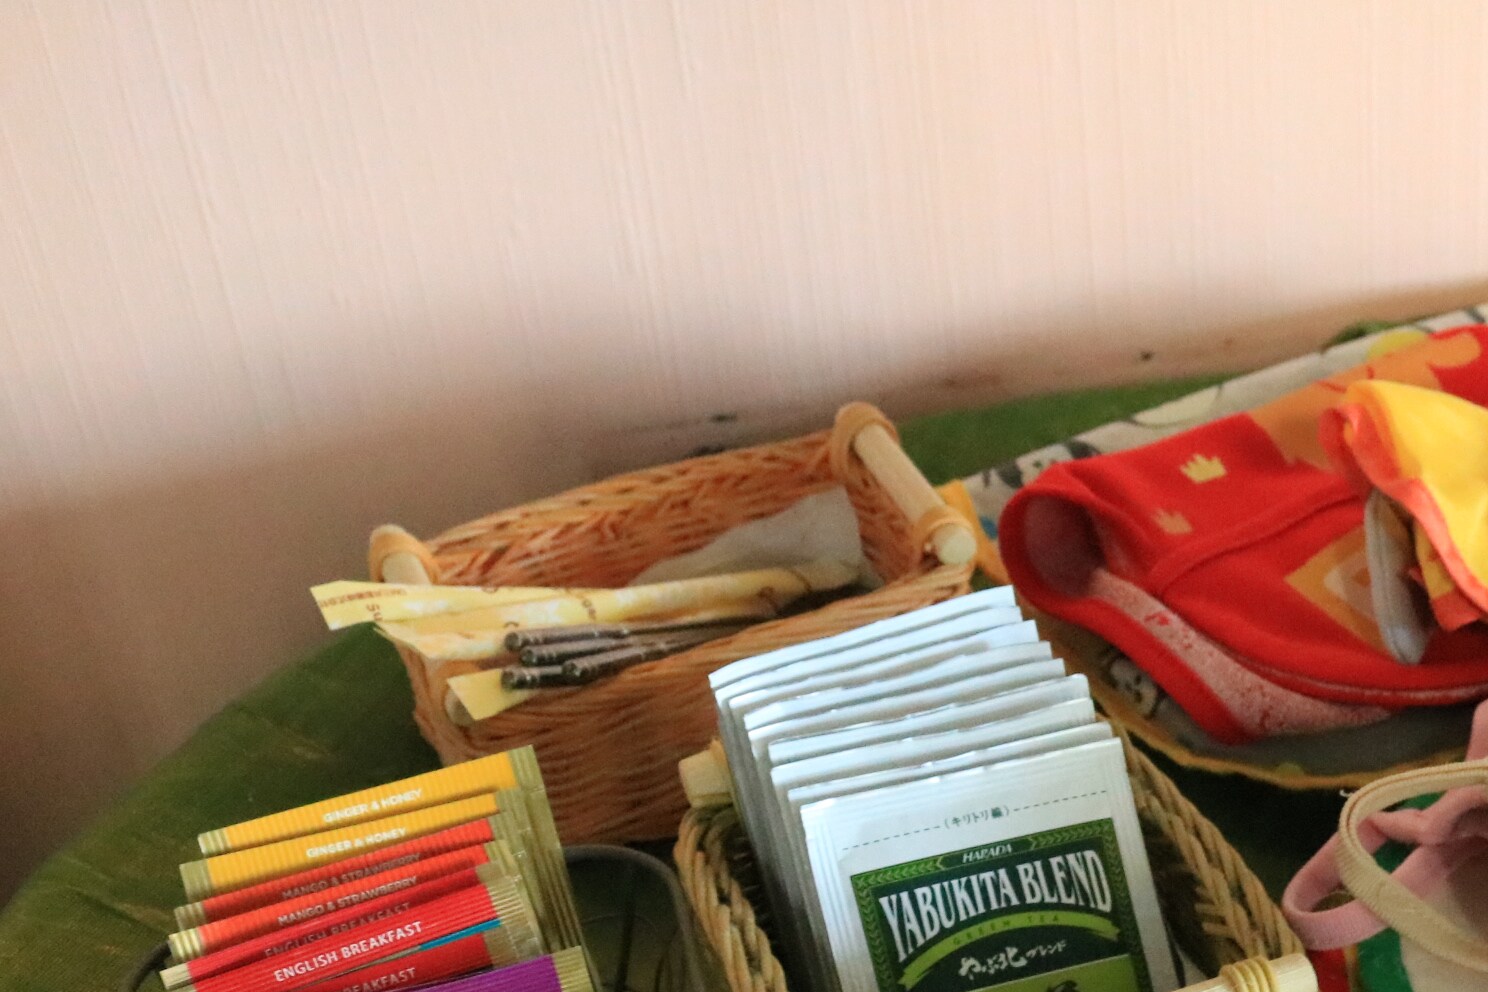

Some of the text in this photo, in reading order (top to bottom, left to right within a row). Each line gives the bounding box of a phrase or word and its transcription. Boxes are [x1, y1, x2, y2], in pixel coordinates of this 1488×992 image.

[323, 803, 369, 822] GINGER
[381, 788, 422, 808] HONEY
[306, 840, 353, 858] GINGER
[365, 827, 406, 844] HONEY
[282, 879, 329, 899] MANGO
[341, 853, 421, 882] STRAWBERRY
[278, 904, 326, 925] MANGO
[337, 876, 417, 907] STRAWBERRY
[878, 849, 1112, 964] YABUKITA BLEND
[274, 921, 422, 982] ENGLISH BREAKFAST
